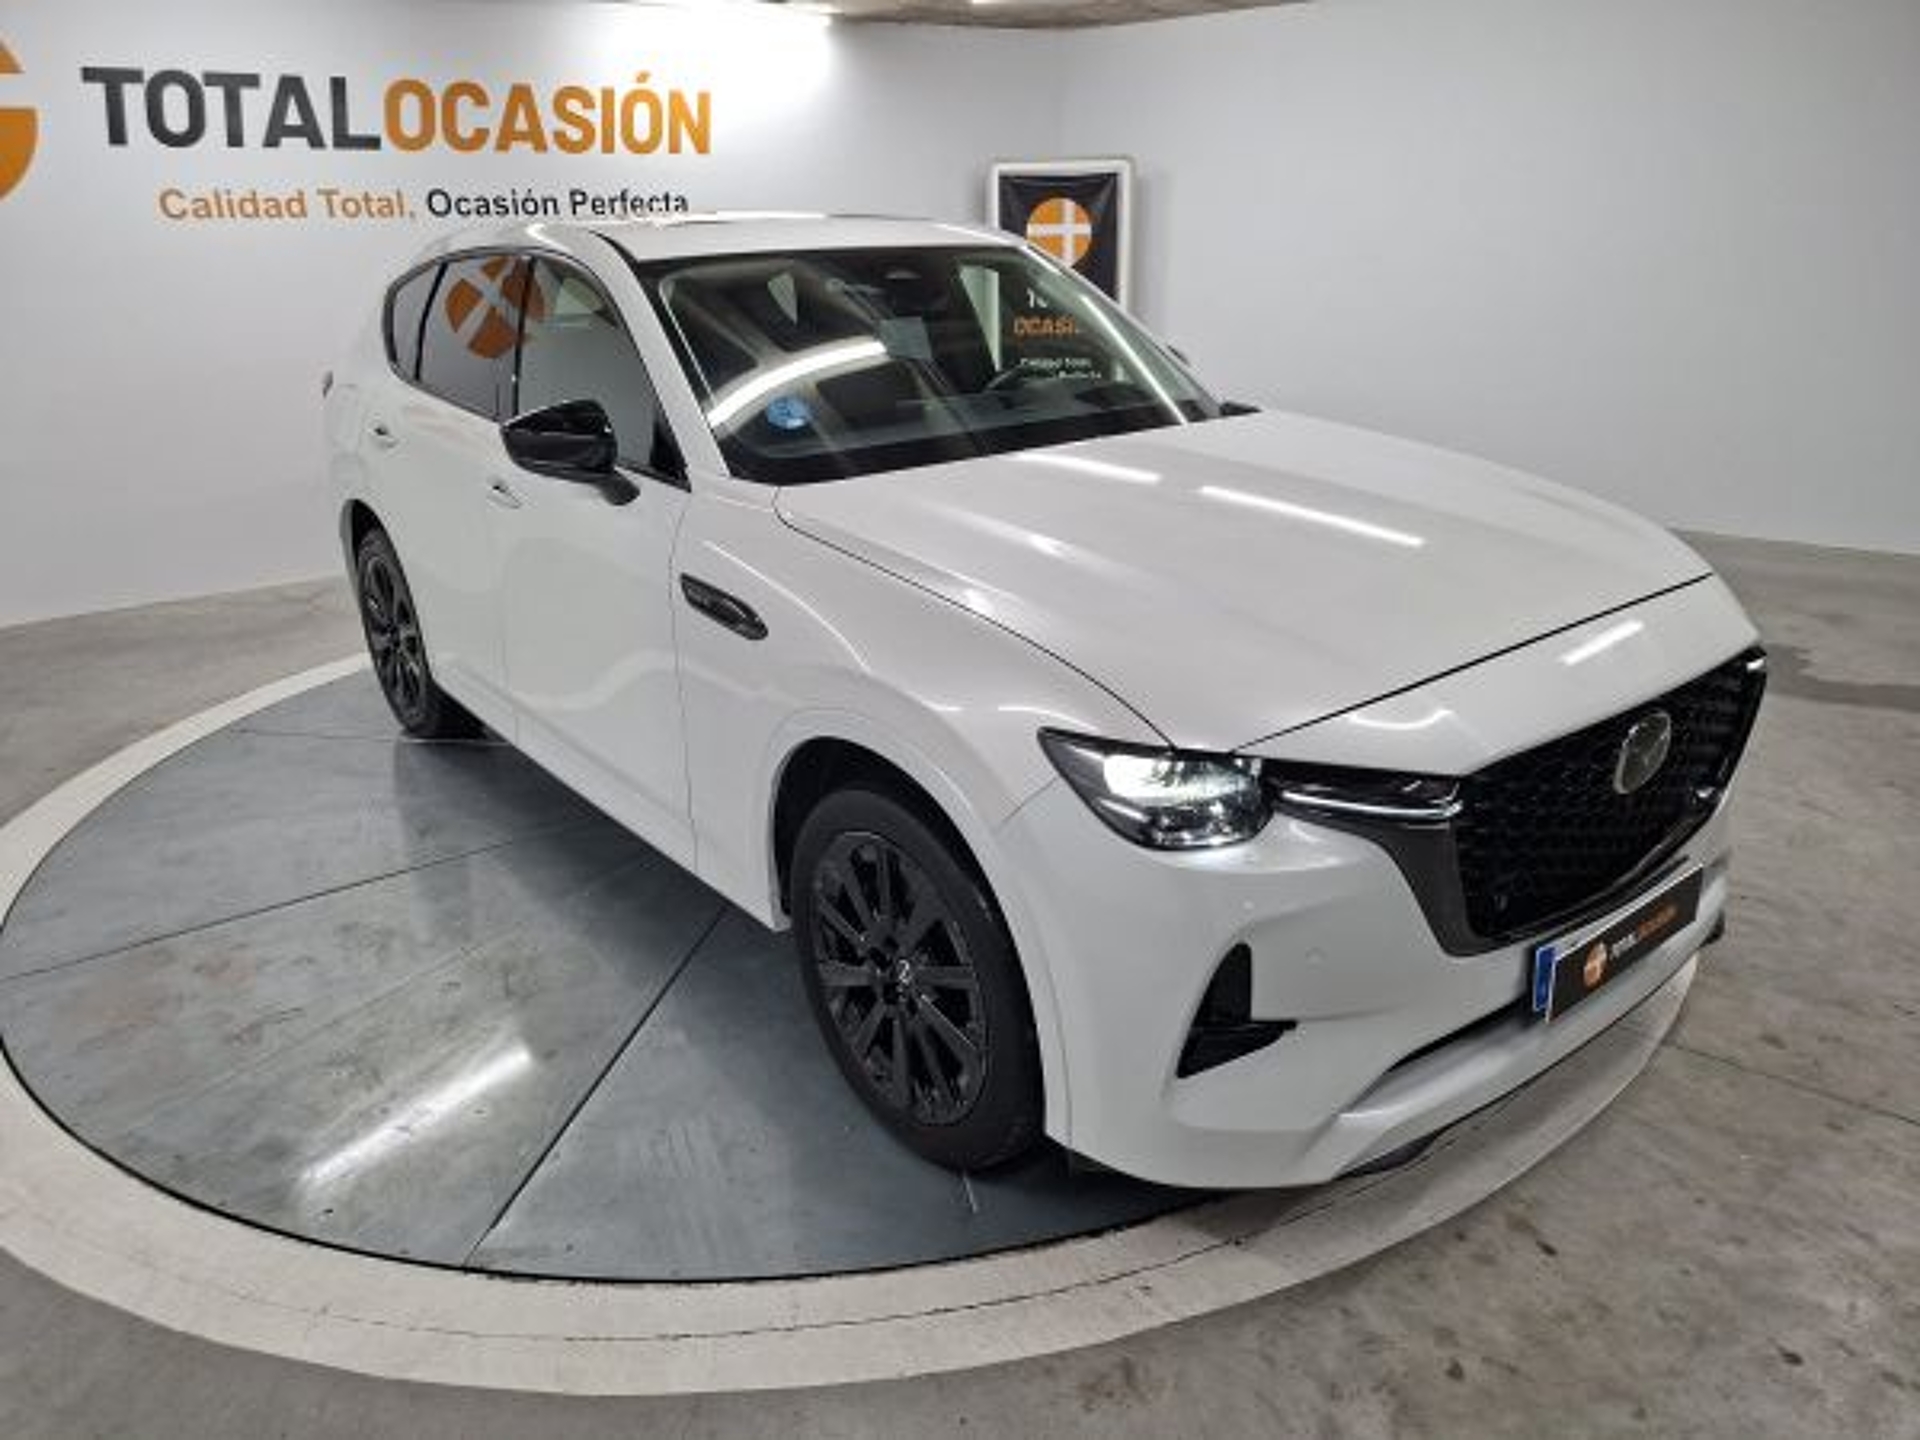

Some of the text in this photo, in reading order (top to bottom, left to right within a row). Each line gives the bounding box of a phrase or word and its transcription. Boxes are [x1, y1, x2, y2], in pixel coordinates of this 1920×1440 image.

[158, 187, 308, 219] Calidad
[427, 188, 560, 217] Ocasión
[569, 188, 689, 216] Perfecta
